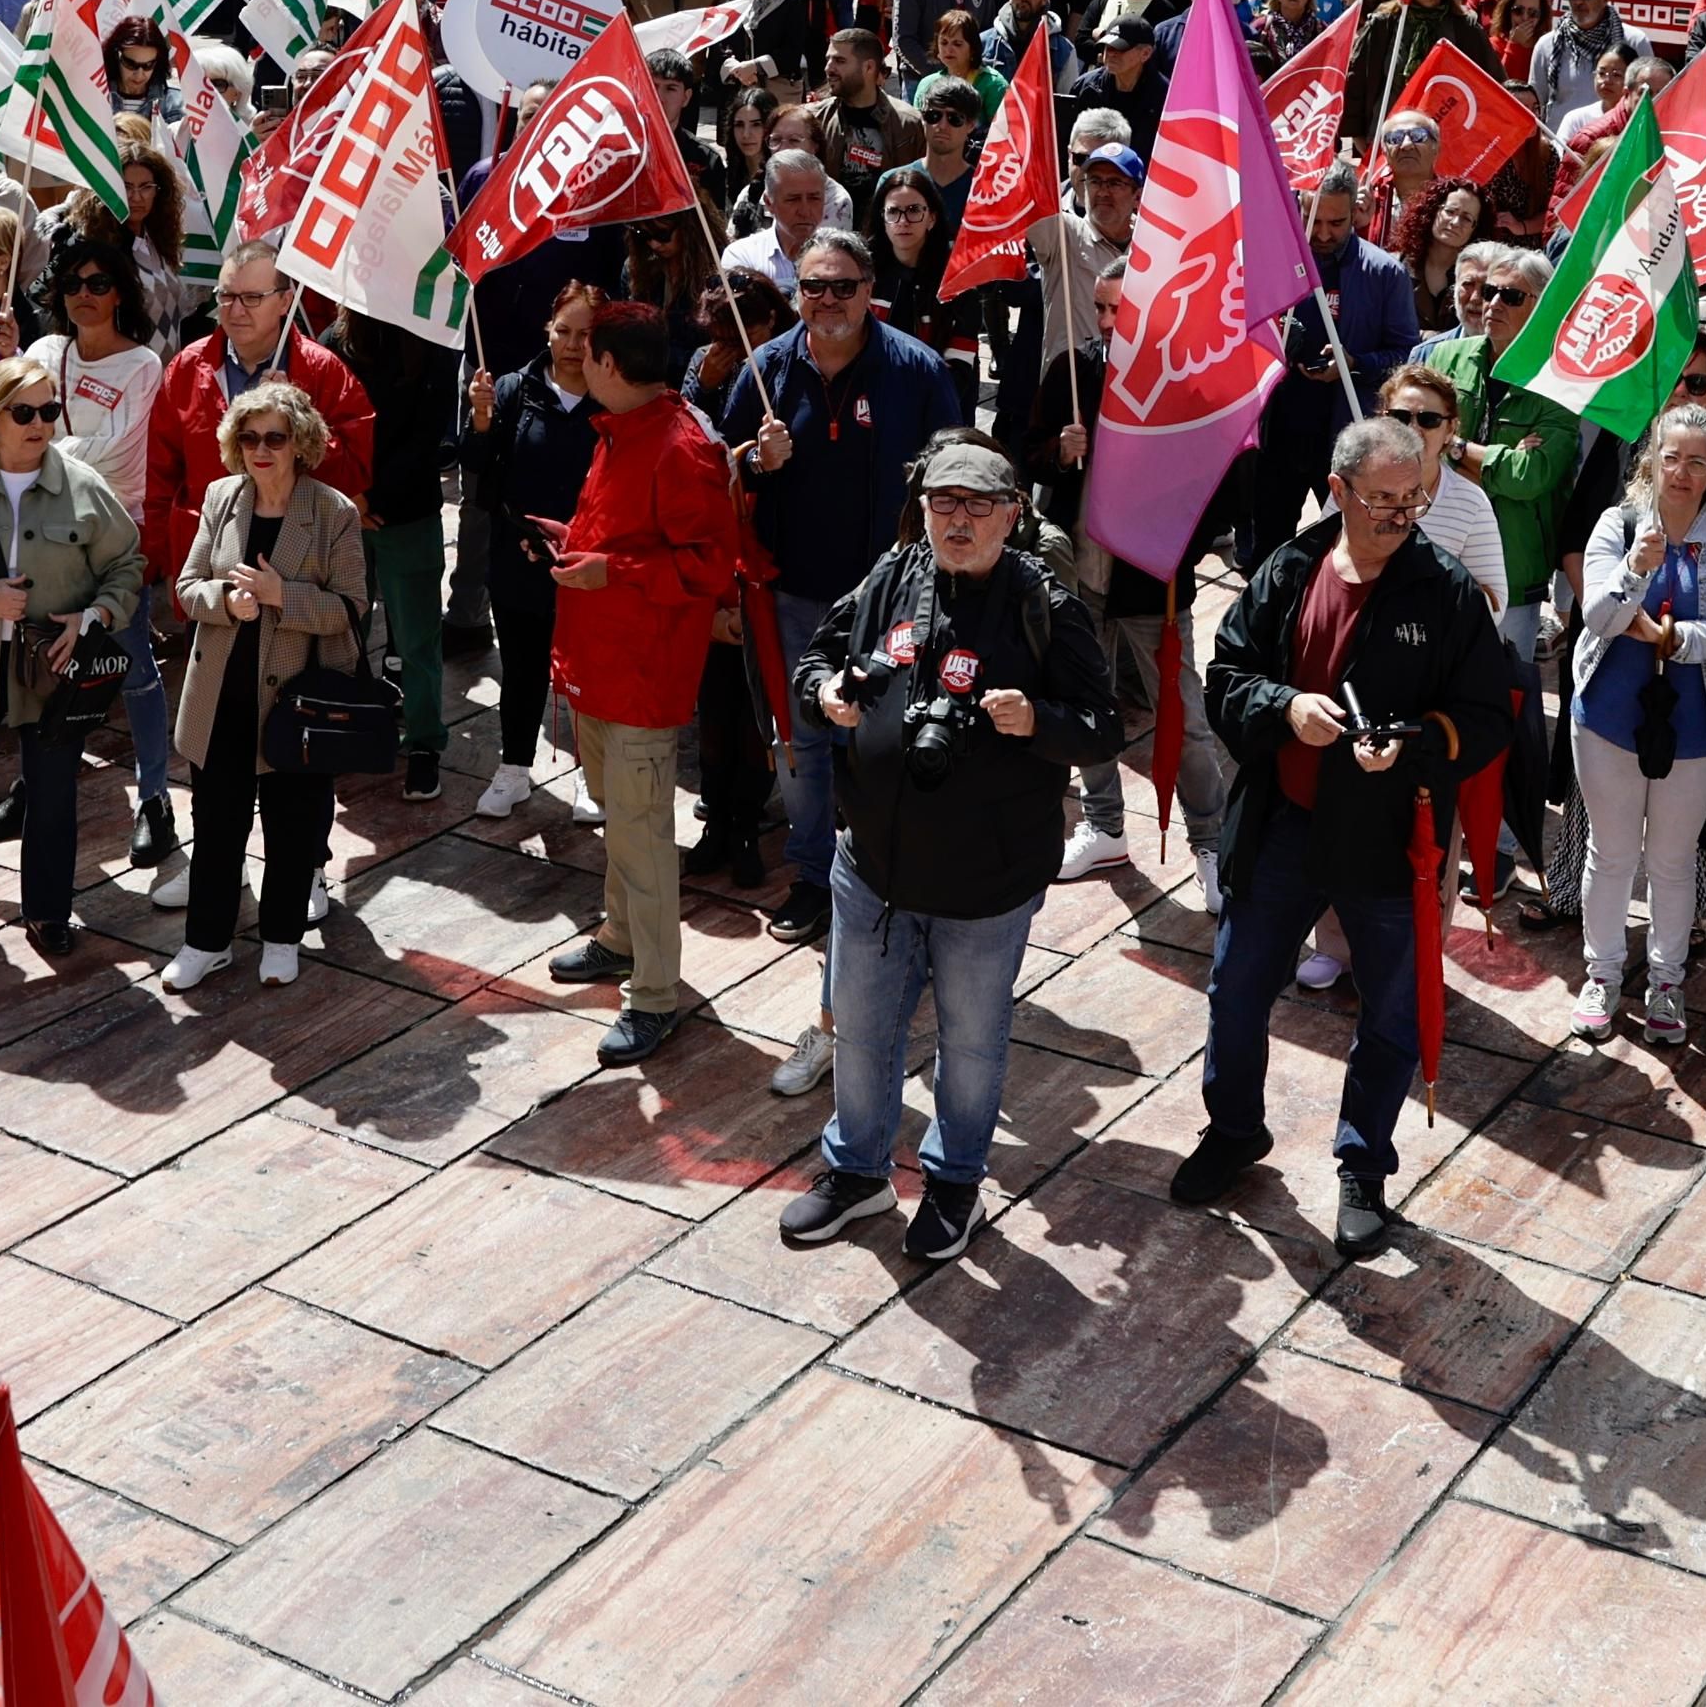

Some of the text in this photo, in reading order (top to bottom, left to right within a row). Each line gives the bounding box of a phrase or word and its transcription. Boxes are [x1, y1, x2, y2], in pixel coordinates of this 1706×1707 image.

[500, 14, 585, 61] hábita
[294, 23, 424, 270] CCOO
[947, 655, 979, 674] UGT
